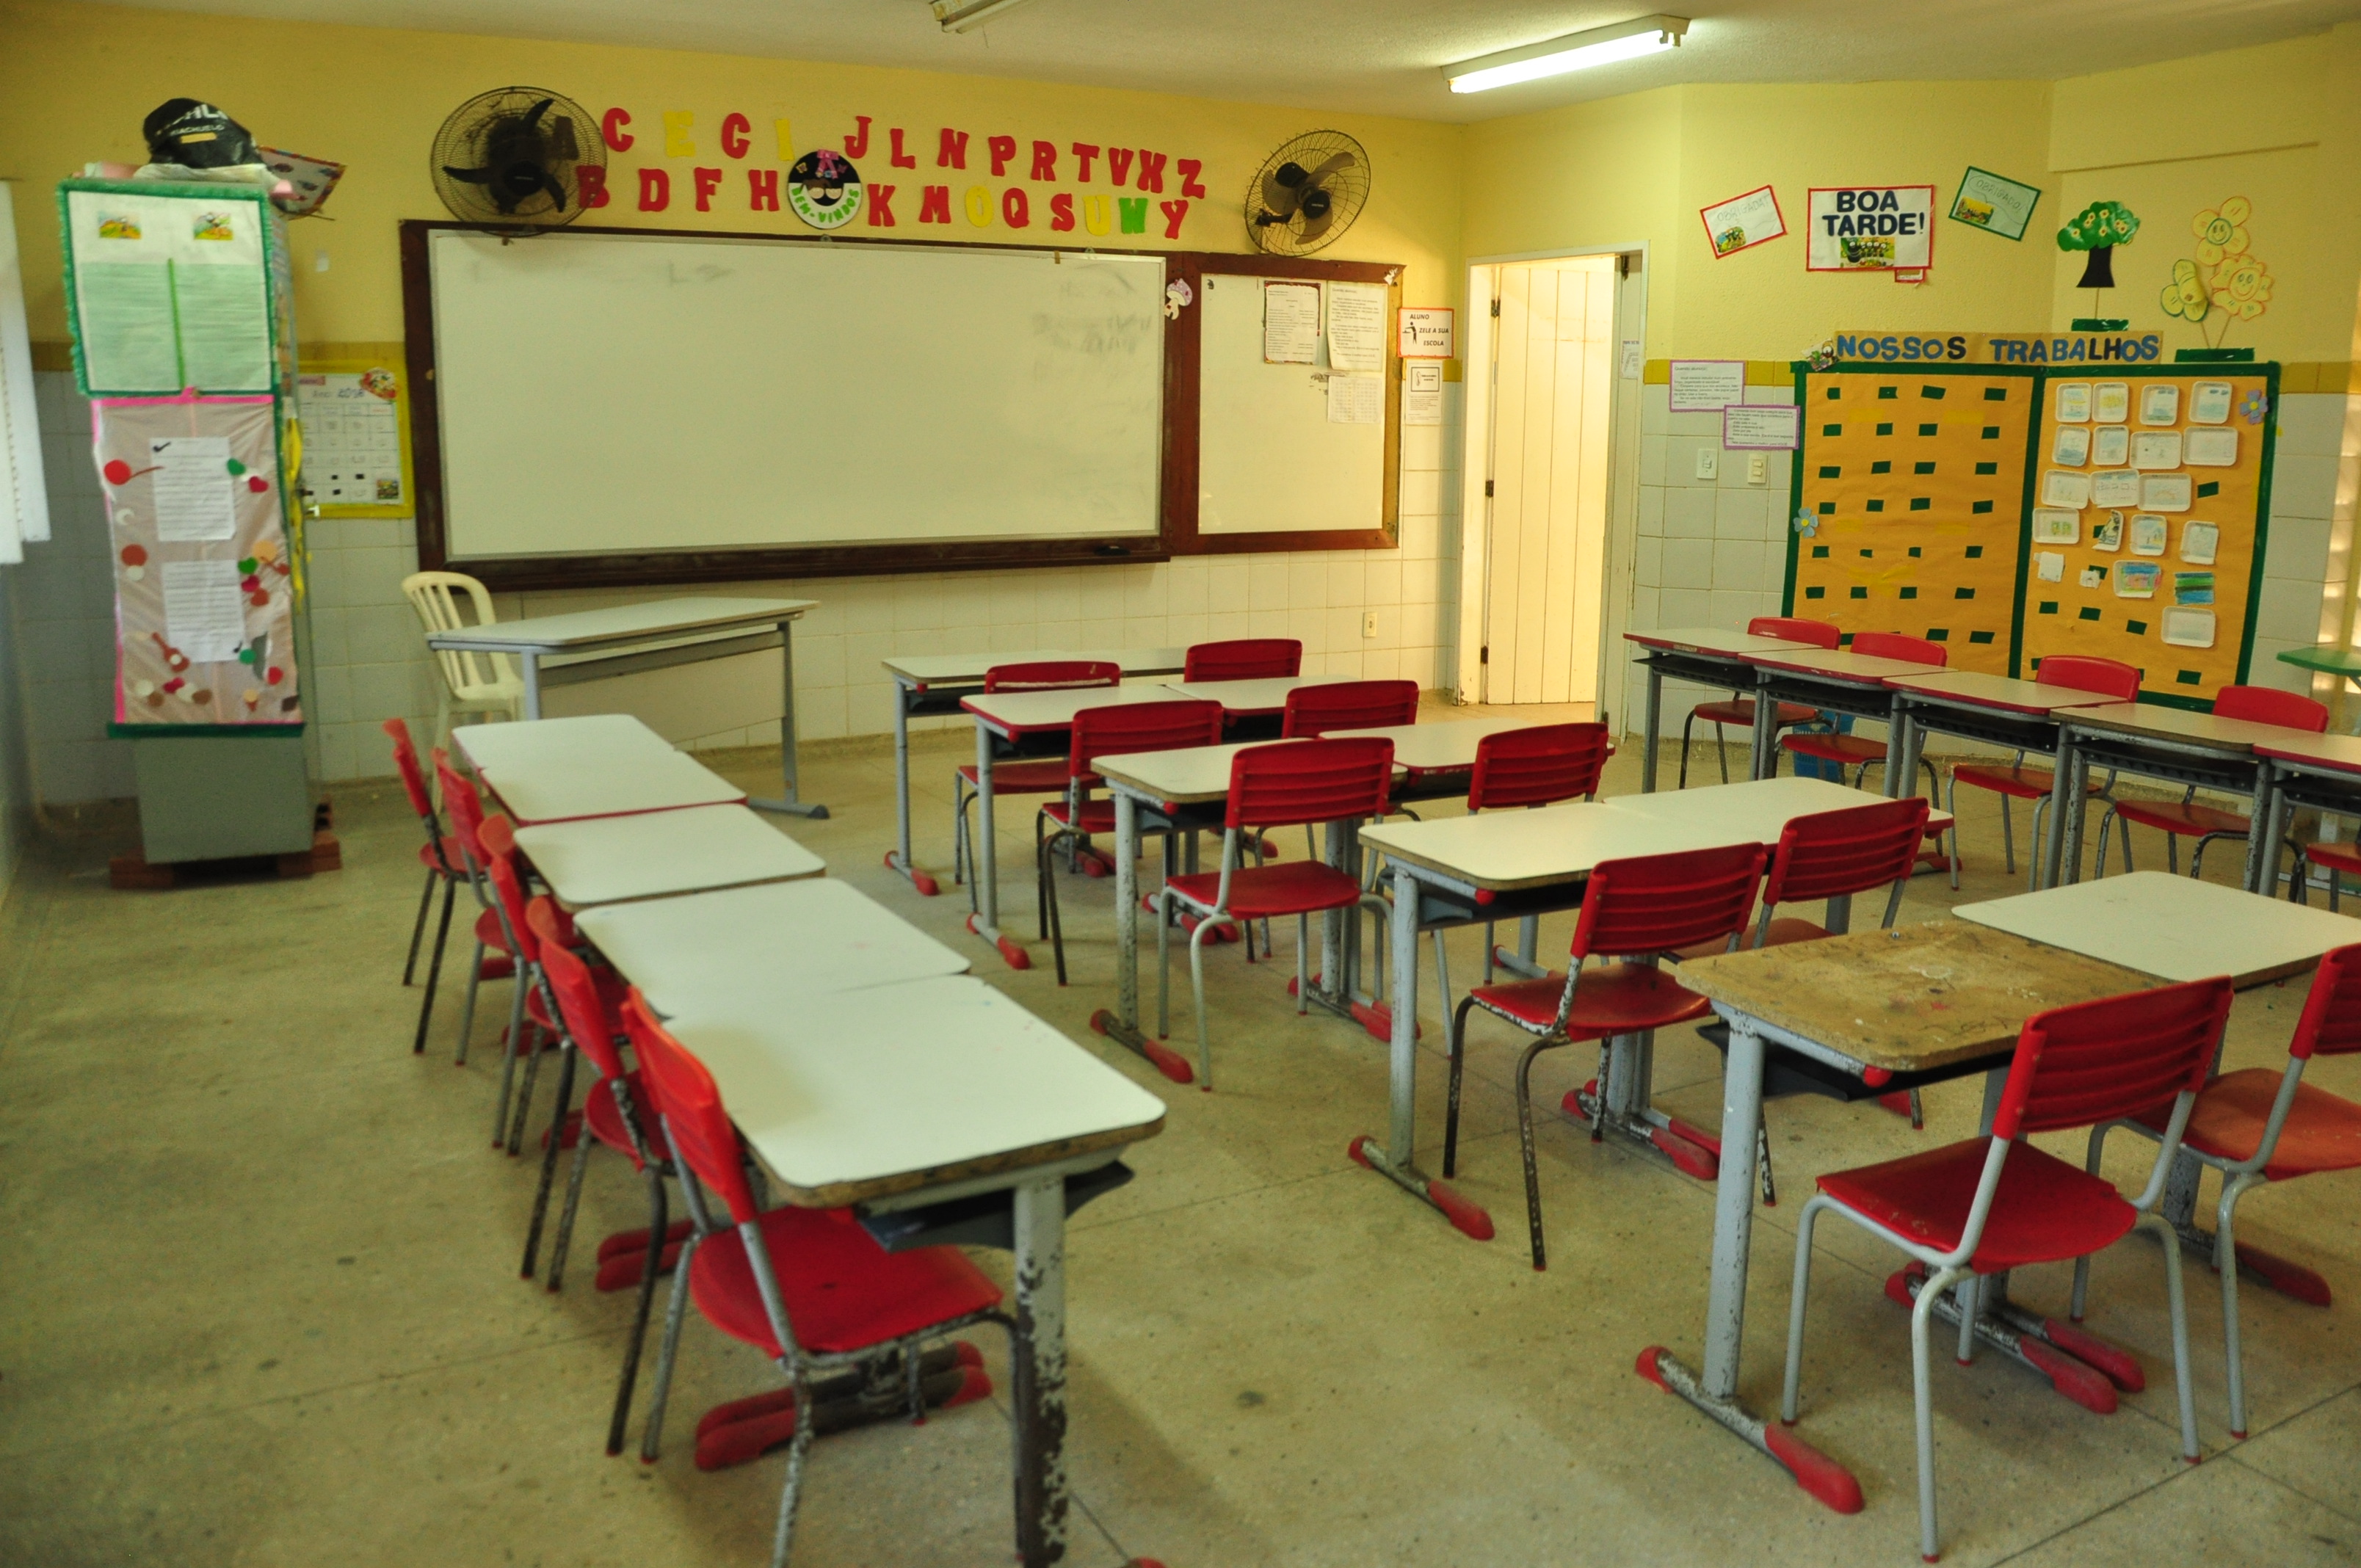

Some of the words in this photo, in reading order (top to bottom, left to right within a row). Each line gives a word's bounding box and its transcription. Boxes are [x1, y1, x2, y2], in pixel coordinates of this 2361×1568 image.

[601, 107, 634, 152] C
[664, 111, 695, 157] E
[844, 115, 872, 159] J
[890, 128, 916, 170] L
[937, 128, 969, 170] N
[987, 135, 1017, 177] P
[1031, 140, 1057, 182] R
[1072, 142, 1100, 183] T
[1108, 147, 1135, 186] V
[1177, 158, 1206, 200] Z
[576, 164, 610, 208] B
[638, 168, 670, 212] D
[694, 167, 722, 212] F
[747, 169, 780, 211] H
[867, 183, 896, 227] K
[918, 185, 952, 224] M
[965, 185, 993, 228] O
[1002, 187, 1031, 229] Q
[1050, 192, 1076, 232] S
[1083, 195, 1111, 236] U
[1118, 197, 1148, 234] W
[1159, 199, 1190, 240] Y
[1836, 190, 1900, 213] BOA
[1821, 211, 1925, 237] TARDE!
[1836, 335, 1968, 362] NOSSOS
[1989, 335, 2159, 363] TRABALHOS
